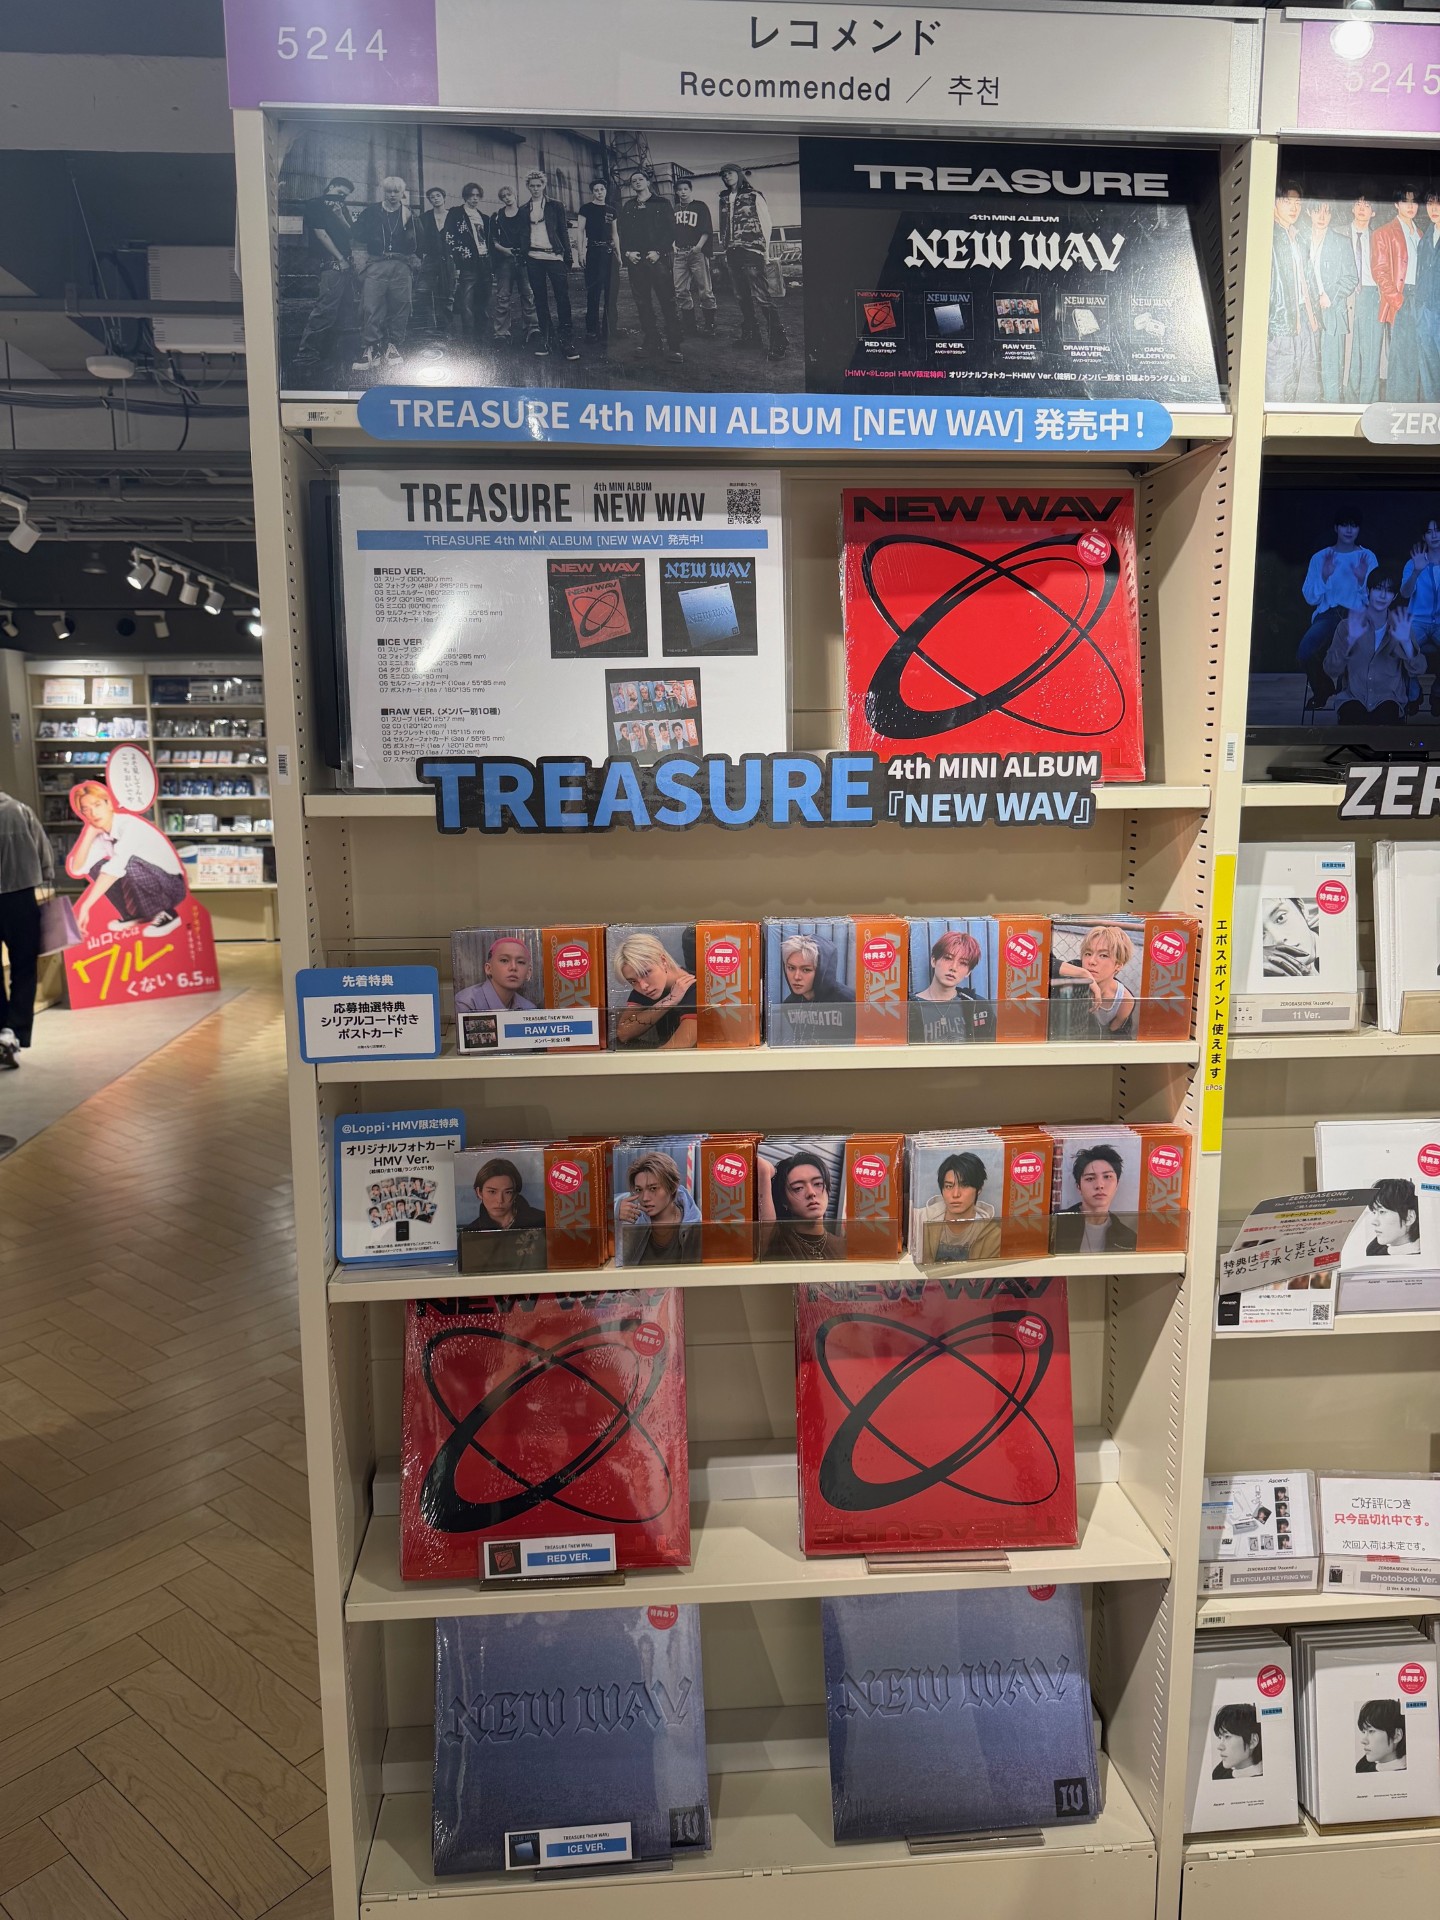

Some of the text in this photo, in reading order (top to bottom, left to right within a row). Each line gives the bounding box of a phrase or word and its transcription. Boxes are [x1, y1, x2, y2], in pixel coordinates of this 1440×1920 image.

[751, 16, 941, 56] レコメンド
[277, 26, 389, 62] 5244
[680, 71, 1000, 107] Recommended 추천
[854, 164, 1169, 197] TREASURE
[969, 213, 991, 221] 4th
[903, 228, 1125, 272] NEW WAV
[391, 399, 570, 430] TREASURE
[579, 403, 634, 432] 4th
[645, 404, 718, 435] MINI
[726, 406, 841, 435] ALBUM
[853, 405, 937, 442] [NEW
[947, 407, 1024, 443] WAV]
[1390, 410, 1440, 437] ZER
[594, 482, 652, 491] 4th MINI ALBUM
[400, 483, 573, 523] TREASURE
[594, 493, 705, 522] NEW WAV
[853, 496, 1124, 523] NEW WAV
[424, 535, 491, 546] TREASURE
[494, 535, 515, 545] 4th
[519, 536, 545, 546] MINI
[549, 534, 593, 546] ALBUM
[597, 534, 627, 547] [NEW
[630, 534, 663, 547] WAV]
[551, 563, 640, 573] NEW WAV
[664, 562, 751, 579] NEW WAV
[887, 753, 1098, 780] 4th MINI ALBUM
[423, 759, 875, 828] TREASURE
[888, 786, 1093, 824] 『NEW WAV』
[1319, 893, 1345, 902] 特典あり
[864, 950, 893, 960] 特典あり
[1008, 941, 1034, 961] 特典あり
[1154, 940, 1181, 957] 特典あり
[558, 958, 588, 968] 特典あり
[708, 955, 738, 964] 特典あり
[126, 973, 173, 996] くない
[177, 971, 203, 987] 6.5
[342, 974, 394, 987] 先着特典
[1210, 921, 1228, 1079] エポスポイント使えます
[334, 1001, 406, 1014] 応募抽選特典
[321, 1014, 419, 1027] シリアルコード付き
[1292, 1011, 1321, 1019] 11 Ver.
[338, 1028, 403, 1039] ポストカード
[524, 1025, 573, 1035] RAW VER.
[346, 1140, 456, 1156] オリジナルフォトカード
[374, 1155, 430, 1166] HMV Ver.
[1150, 1156, 1179, 1169] 特典あり
[717, 1163, 744, 1178] 特典あり
[854, 1166, 885, 1179] 特典あり
[1013, 1163, 1042, 1175] 特典あり
[551, 1170, 579, 1186] 特典あり
[1289, 1191, 1349, 1200] ZEROBASEONE
[1224, 1236, 1335, 1269] 特典は終了しました。
[1224, 1245, 1334, 1278] 予めご了承ください。
[1351, 1497, 1411, 1509] ご好評につき
[1334, 1513, 1429, 1527] 只今品切れ中です。
[1342, 1540, 1425, 1551] 次回入荷は未定です。
[547, 1553, 590, 1563] RED VER.
[1370, 1574, 1418, 1583] Photobook
[1261, 1675, 1283, 1689] 特典あり
[567, 1843, 606, 1853] ICE VER.
